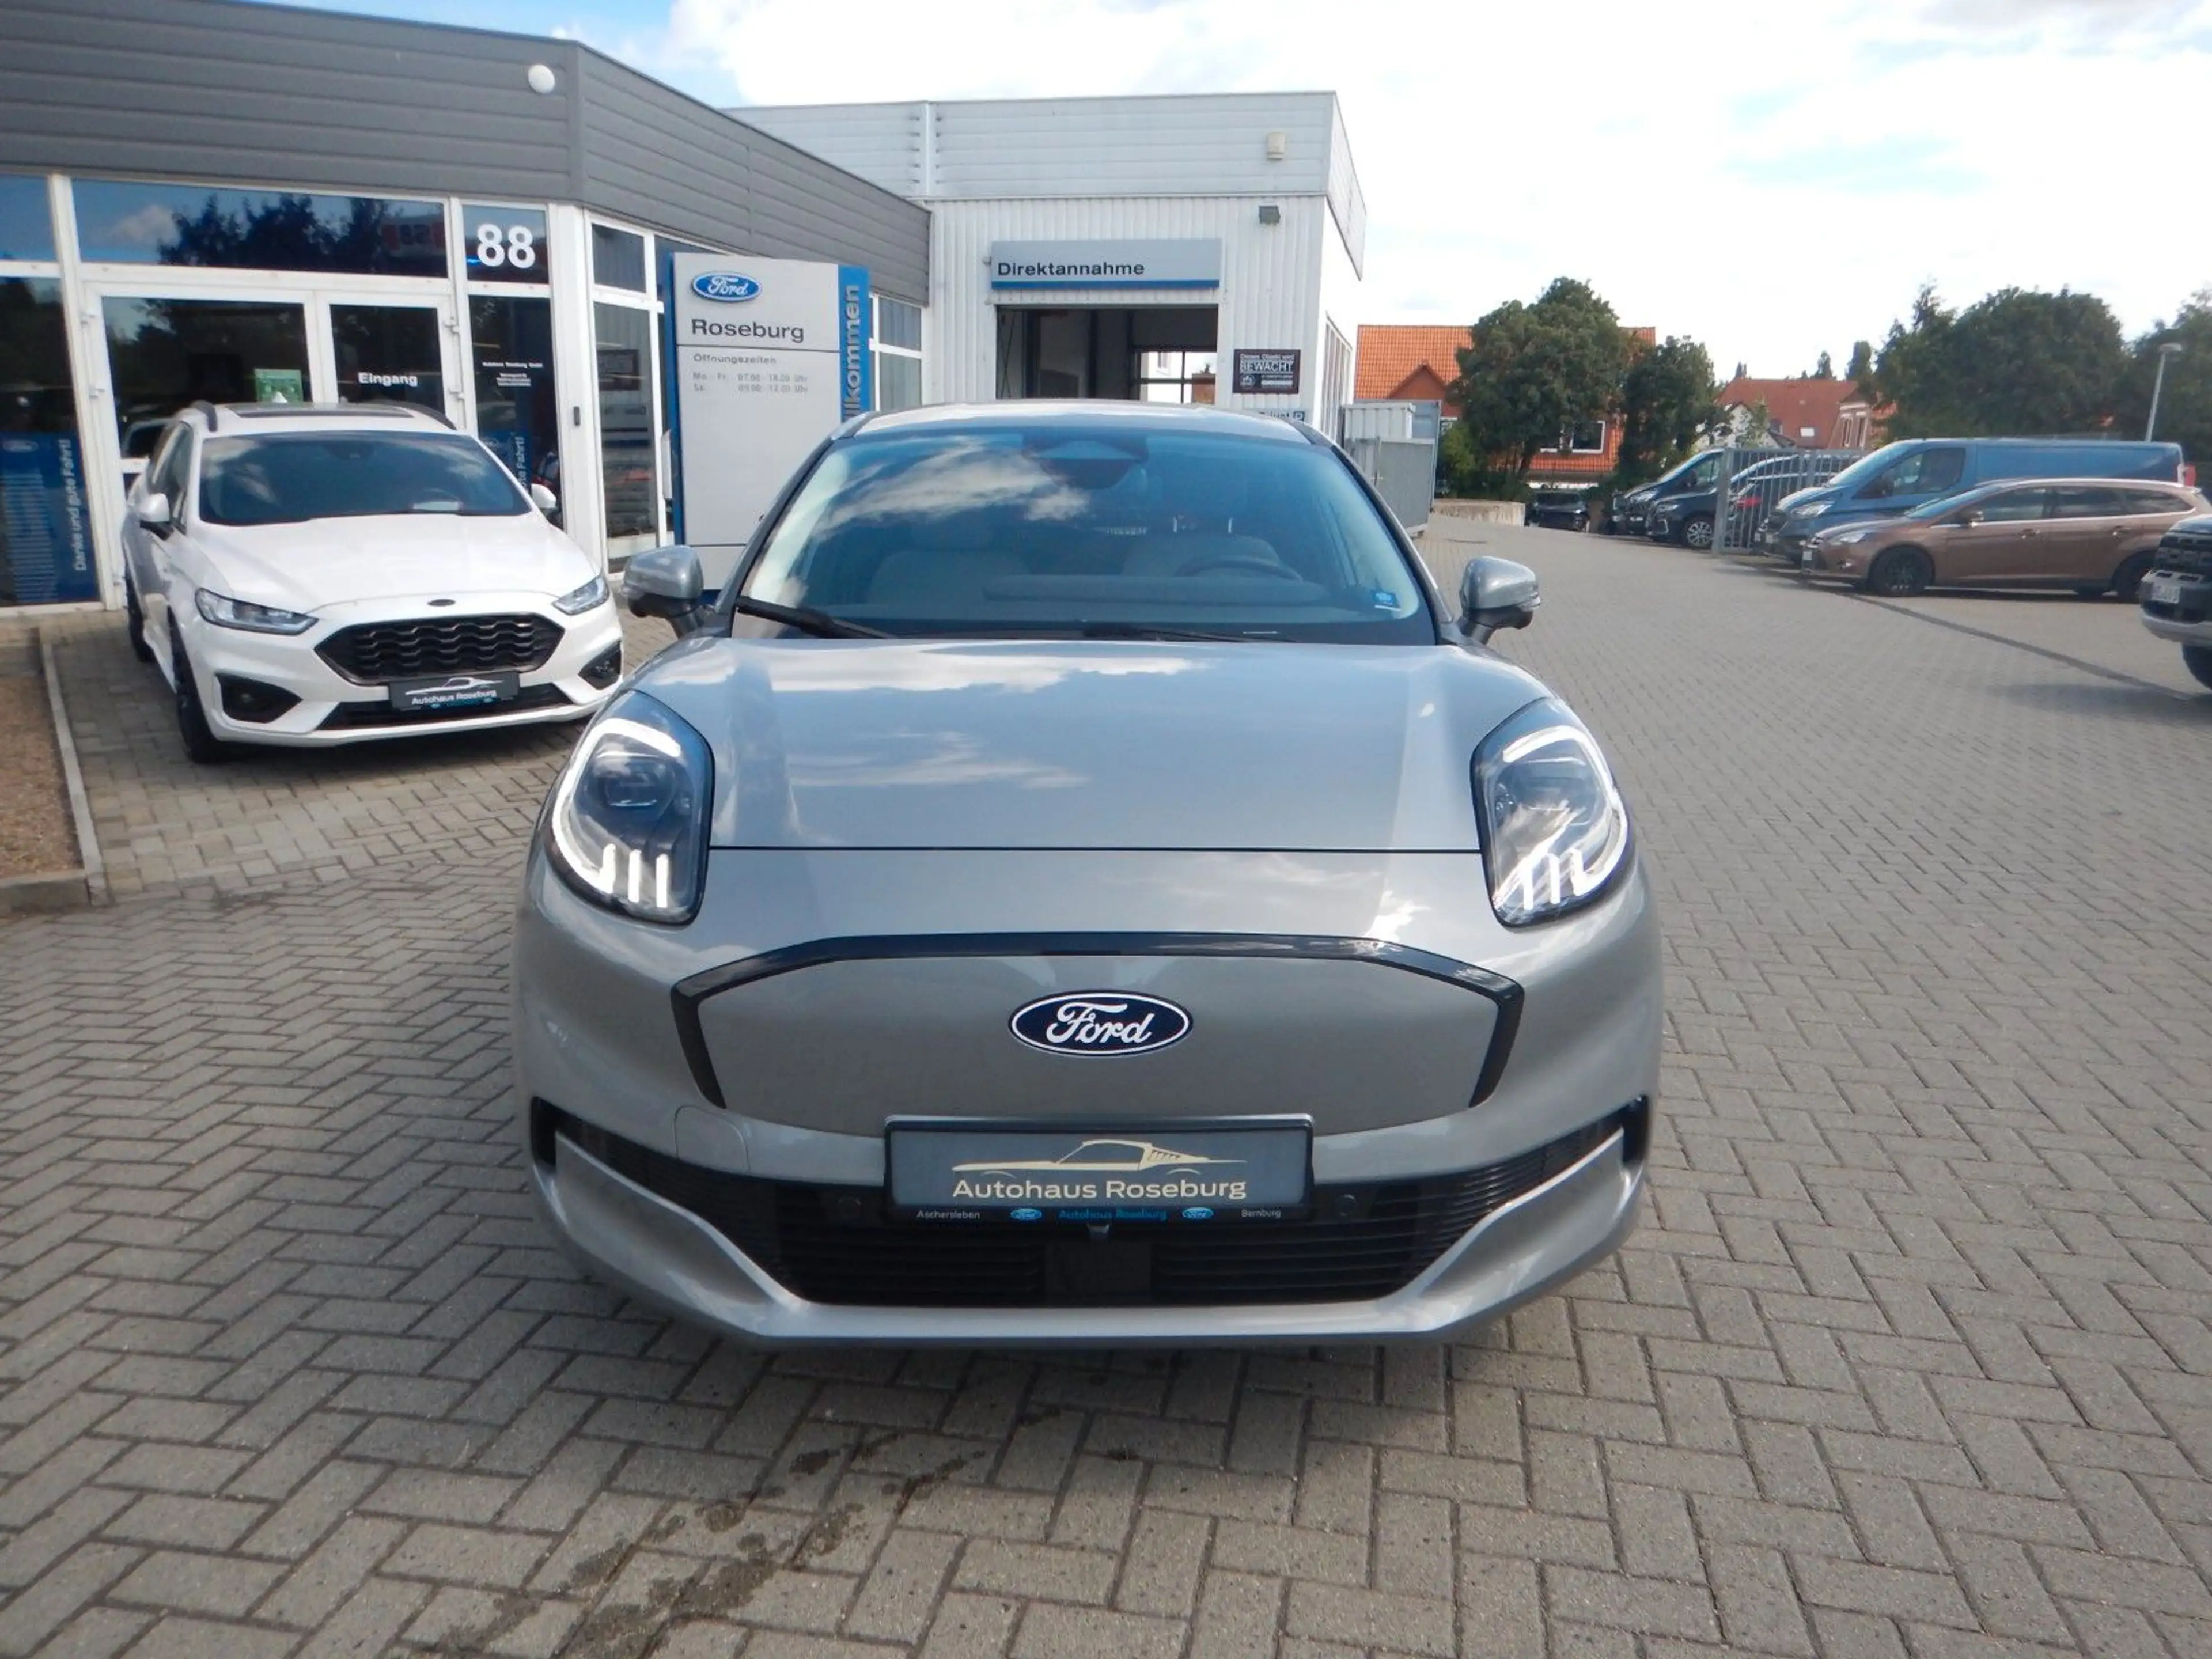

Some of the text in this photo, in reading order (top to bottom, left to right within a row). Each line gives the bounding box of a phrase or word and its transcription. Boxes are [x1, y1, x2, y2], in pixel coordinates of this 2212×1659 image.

[477, 224, 536, 269] 88
[998, 262, 1145, 276] Direktannahme
[706, 276, 749, 296] Ford
[691, 318, 804, 343] Roseburg
[844, 285, 861, 419] llkommen
[1240, 360, 1295, 373] BEWACHT
[358, 372, 418, 387] Eingang
[412, 695, 455, 705] Autohaus
[1046, 1002, 1155, 1044] Ford
[952, 1179, 1247, 1200] Autohaus Roseburg
[916, 1209, 980, 1219] Aschersleben
[1058, 1209, 1112, 1219] Autohaus
[1115, 1209, 1167, 1220] Roseburg
[1241, 1207, 1282, 1219] Bernburg
